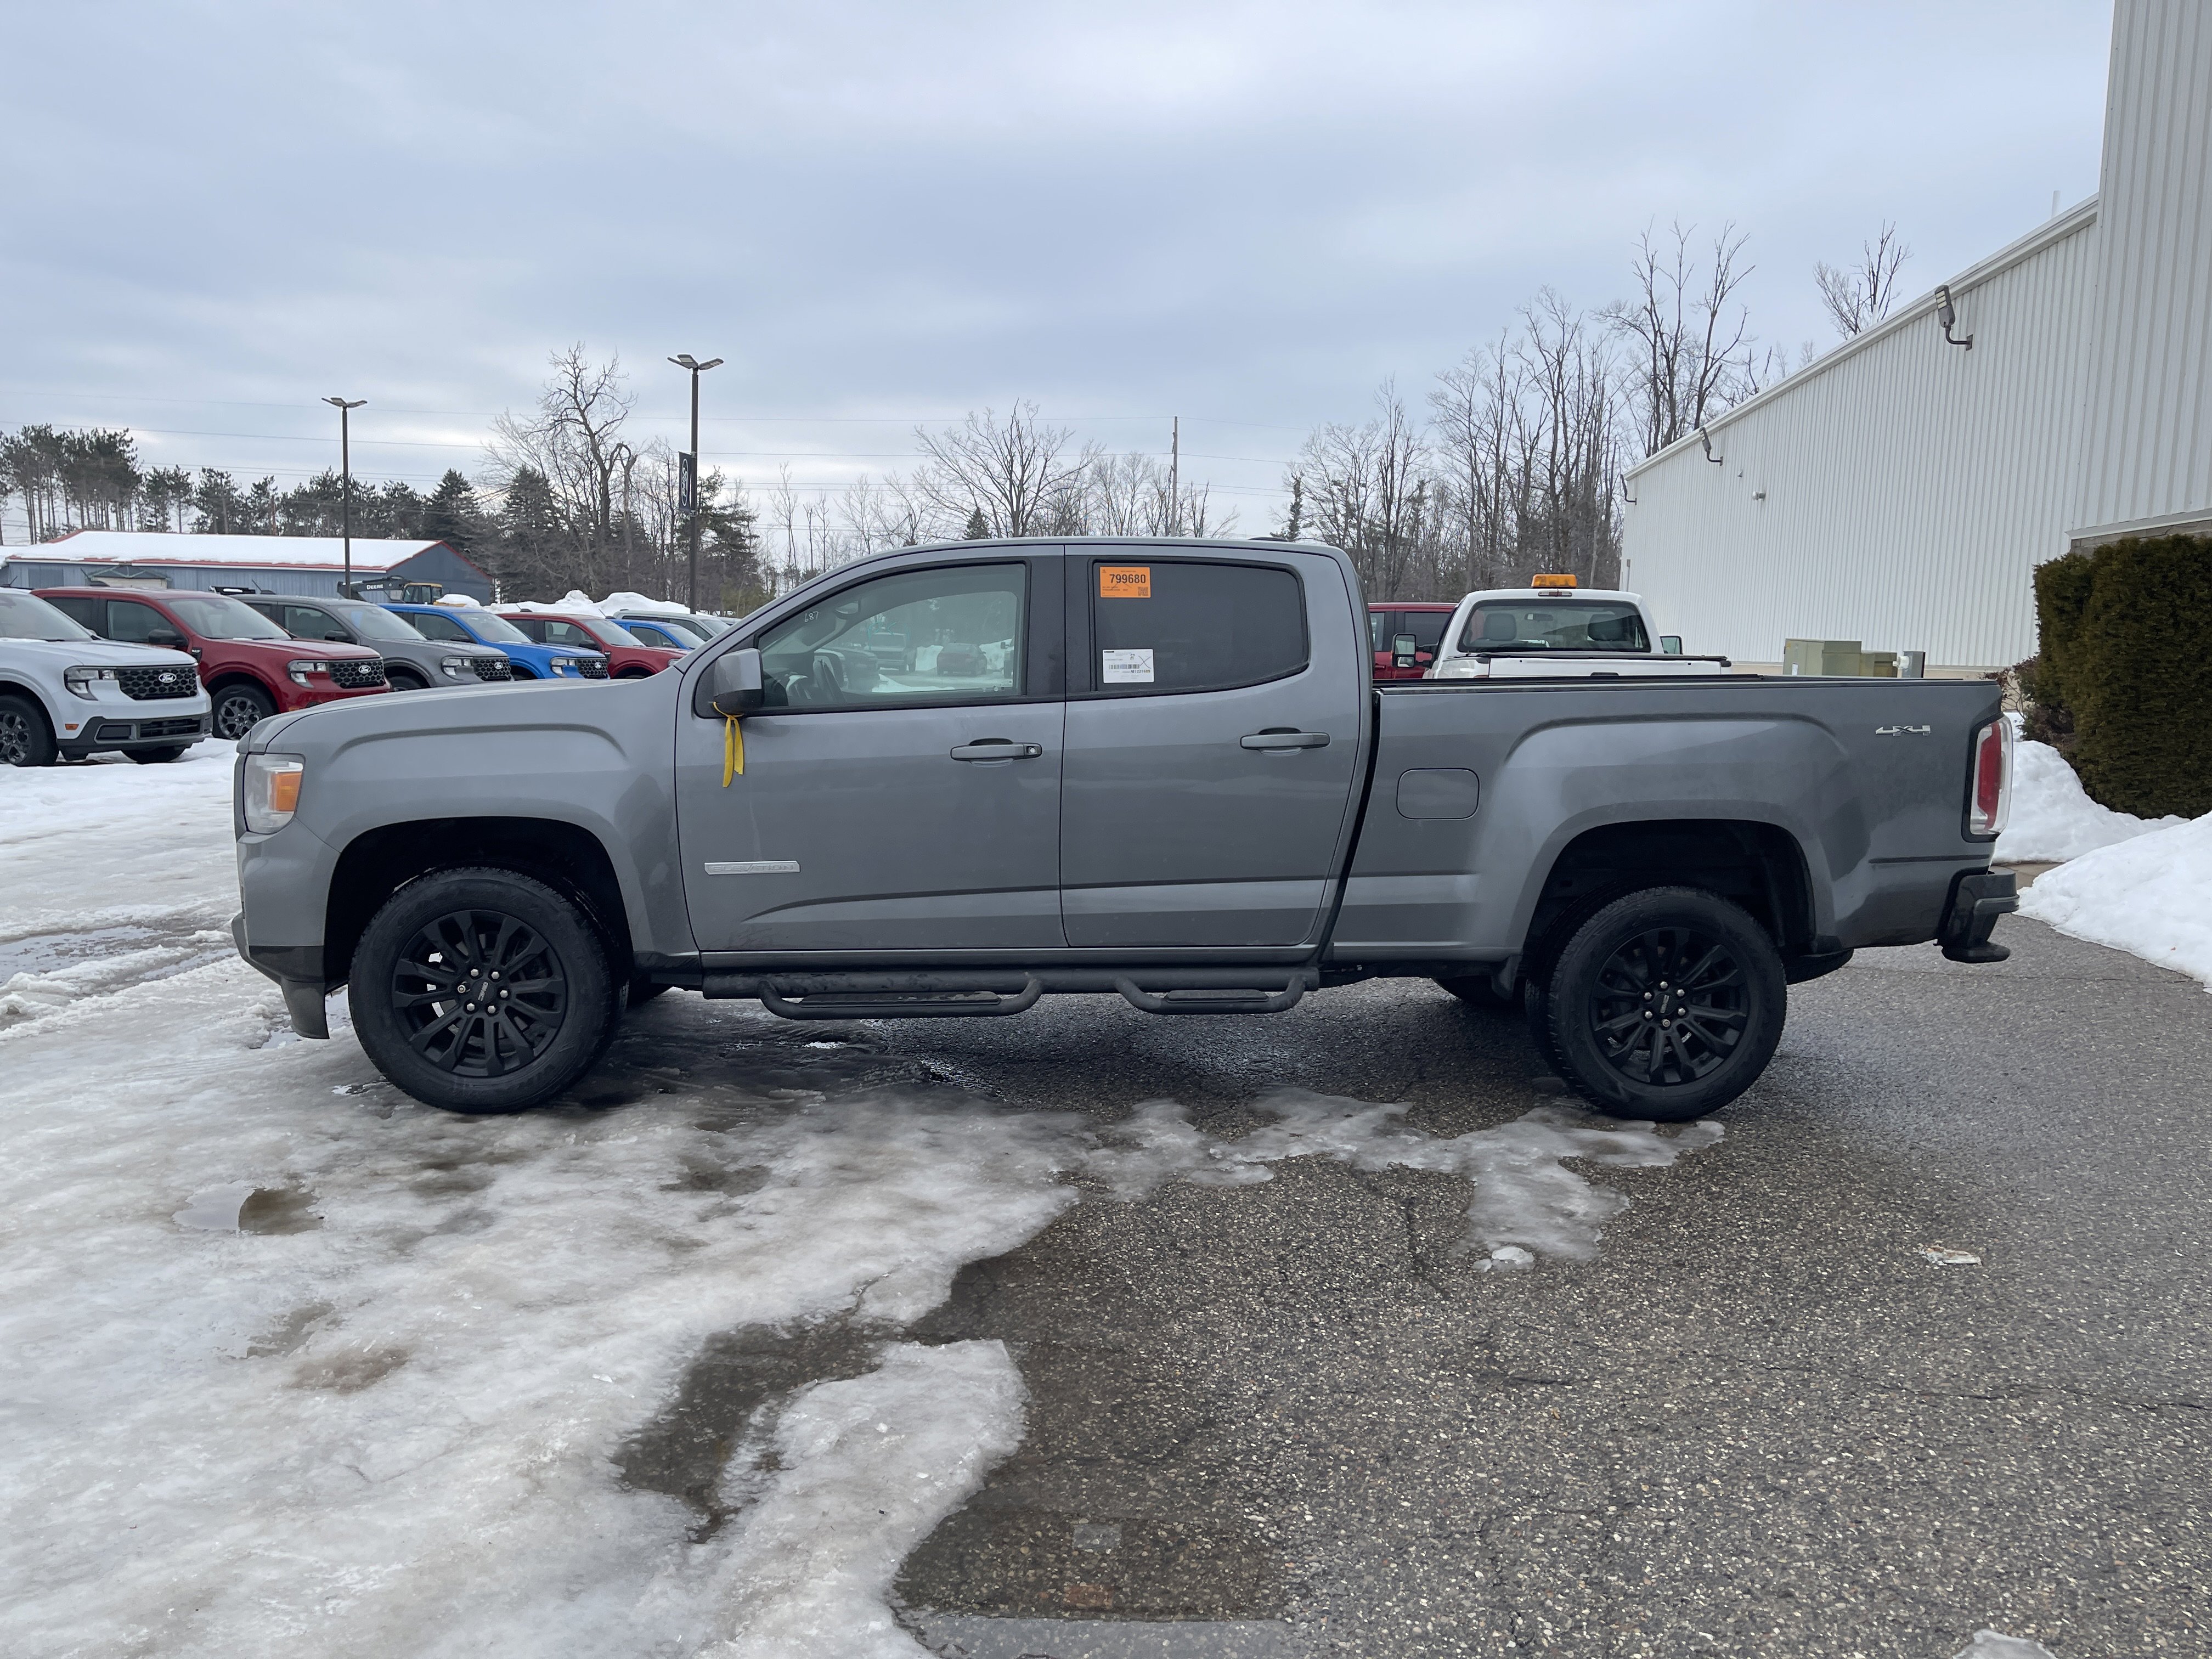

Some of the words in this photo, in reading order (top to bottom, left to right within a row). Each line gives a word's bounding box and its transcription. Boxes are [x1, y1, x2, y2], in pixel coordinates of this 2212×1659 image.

[1109, 574, 1146, 584] 799680
[804, 611, 819, 623] 687
[161, 674, 174, 682] Ford
